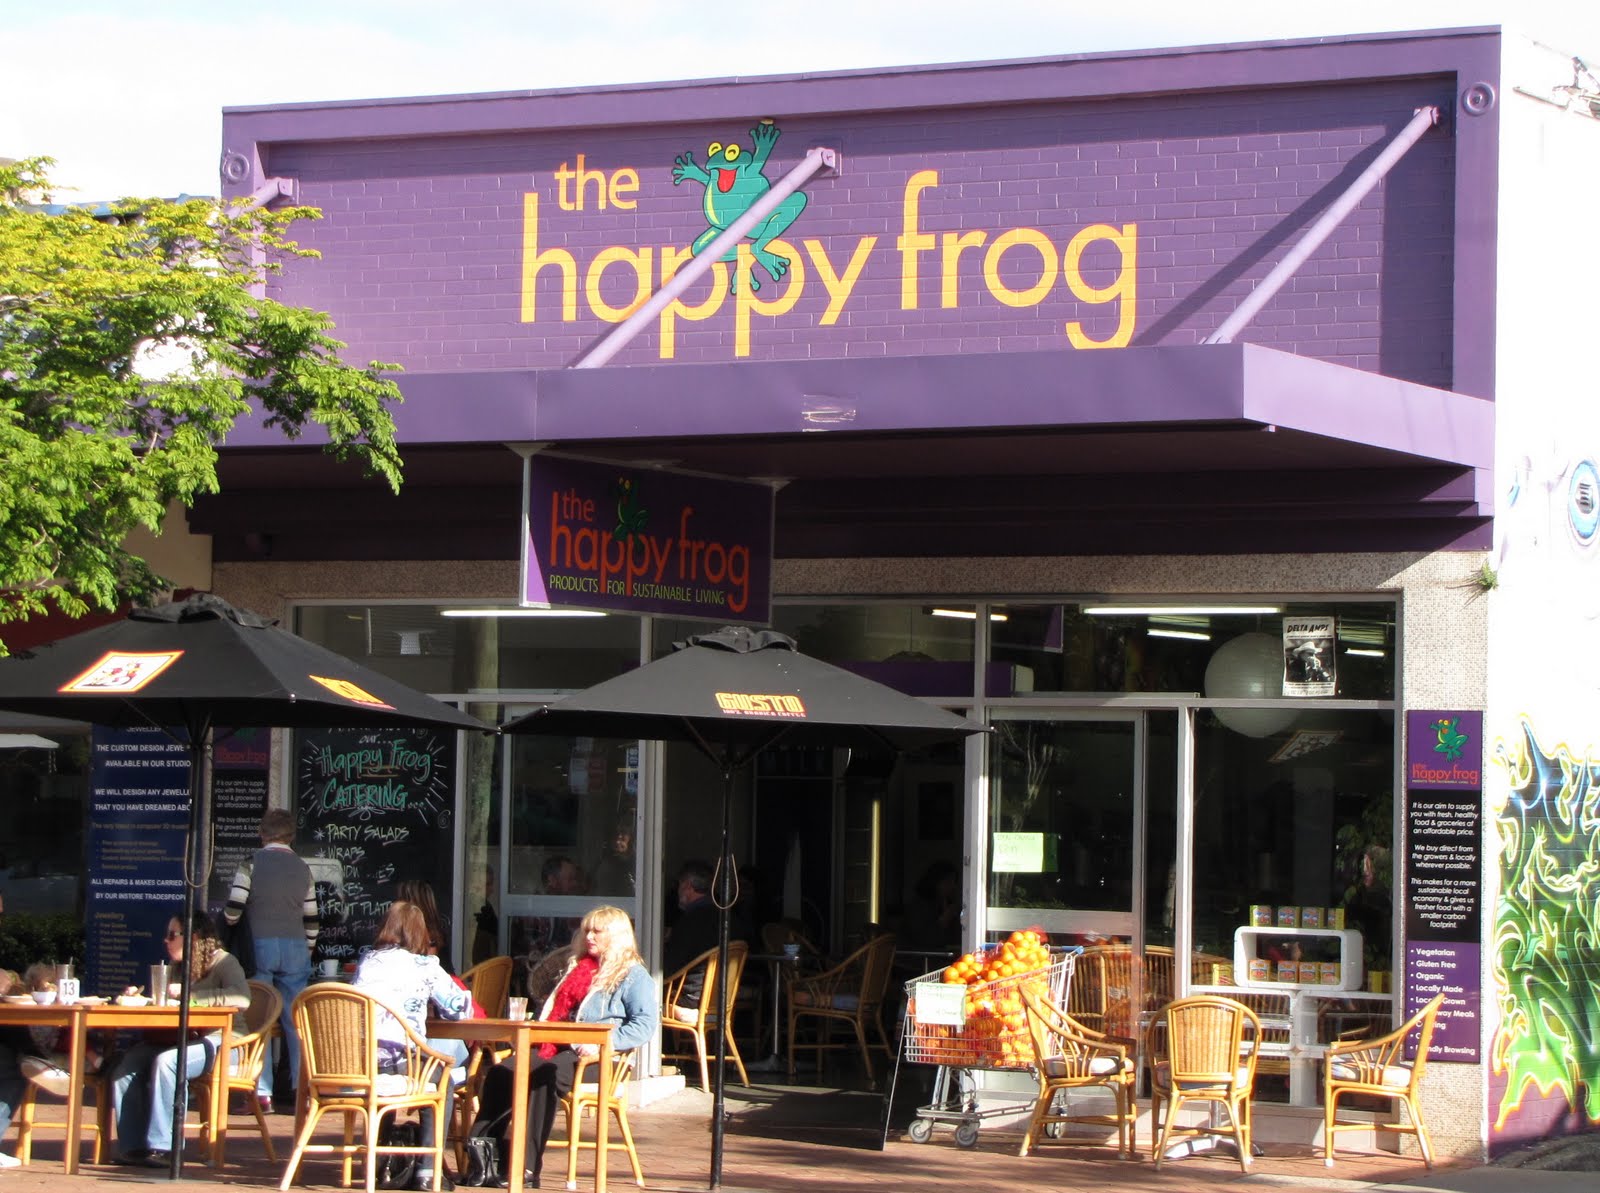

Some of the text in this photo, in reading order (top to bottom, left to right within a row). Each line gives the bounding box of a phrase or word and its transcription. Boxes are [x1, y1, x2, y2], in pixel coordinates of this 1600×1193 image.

[555, 154, 640, 211] the
[520, 170, 1137, 359] happy frog
[562, 488, 595, 522] the
[550, 490, 750, 613] happy frog
[549, 574, 725, 605] PRODUCTS FOR SUSTAINABLE LIVING
[1287, 624, 1329, 633] DELTA AMPS
[715, 692, 806, 713] GUSTO
[96, 744, 110, 752] THE
[110, 744, 139, 752] CUSTOM
[139, 744, 165, 752] DESIGN
[315, 739, 431, 784] Happy Frog
[1412, 763, 1479, 785] happy frog
[95, 788, 190, 796] WE WILL DESIGN ANY JEWELL
[95, 803, 111, 811] THAT
[111, 803, 126, 811] YOU
[126, 803, 144, 811] HAVE
[144, 803, 176, 811] DREAMED
[1455, 803, 1477, 811] supply
[1454, 811, 1479, 820] healthy
[1437, 820, 1466, 828] groceries
[325, 823, 410, 843] PARTY SALADS
[1426, 844, 1438, 852] buy
[328, 846, 366, 861] WRAPS
[1423, 853, 1448, 861] growers
[1455, 854, 1476, 862] locally
[91, 878, 103, 886] ALL
[103, 878, 128, 886] REPAIRS
[1411, 877, 1422, 885] This
[95, 892, 186, 901] BY OUR INSTORE TRADESPEOP
[1449, 896, 1466, 904] gives
[1415, 948, 1456, 957] Vegetarian
[1415, 960, 1457, 969] Gluten Free
[1415, 972, 1445, 981] Organic
[63, 982, 76, 996] 13
[1415, 984, 1464, 993] Locally Made
[1441, 997, 1467, 1005] Grown
[1453, 1009, 1476, 1018] Meals
[1443, 1046, 1476, 1057] Browsing
